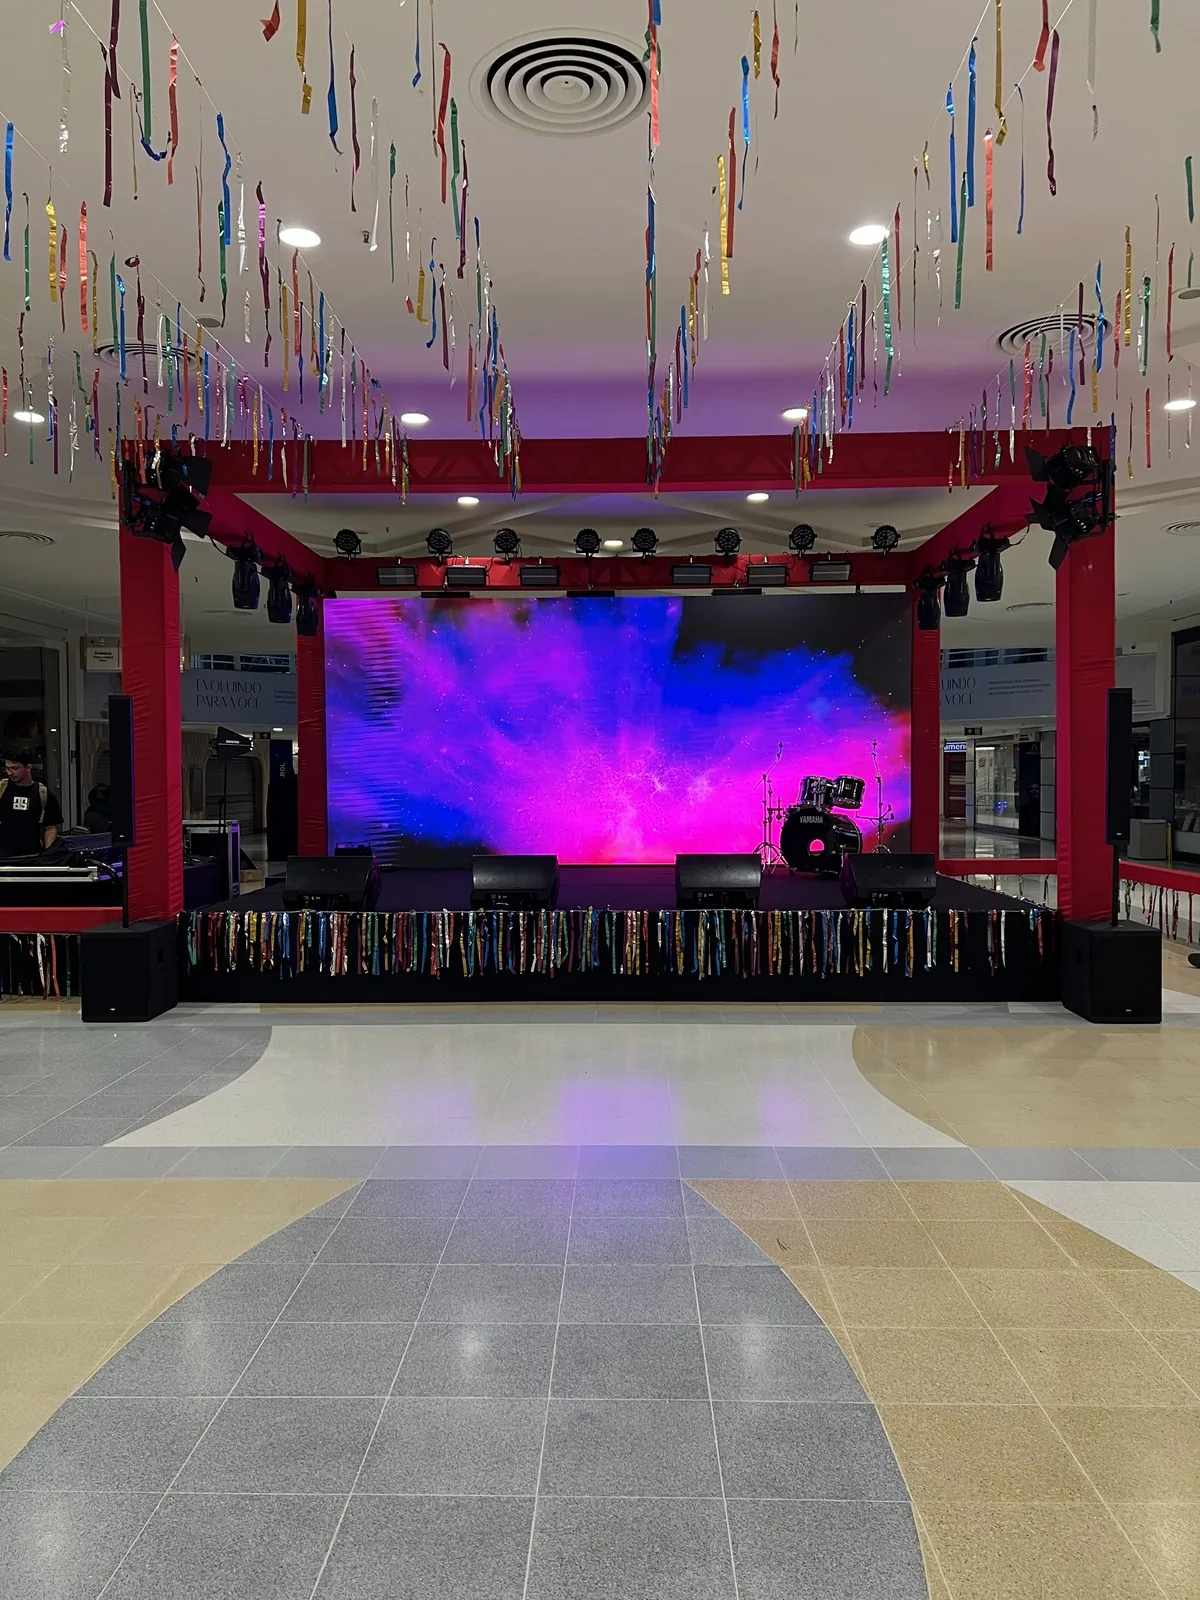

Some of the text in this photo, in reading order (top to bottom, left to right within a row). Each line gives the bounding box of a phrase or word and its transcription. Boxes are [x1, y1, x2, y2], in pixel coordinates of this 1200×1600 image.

[196, 678, 262, 694] EVOLUINDO
[941, 675, 976, 691] UINDO
[196, 694, 228, 708] PARA
[943, 743, 967, 751] ameri
[799, 815, 824, 824] YAMAHA
